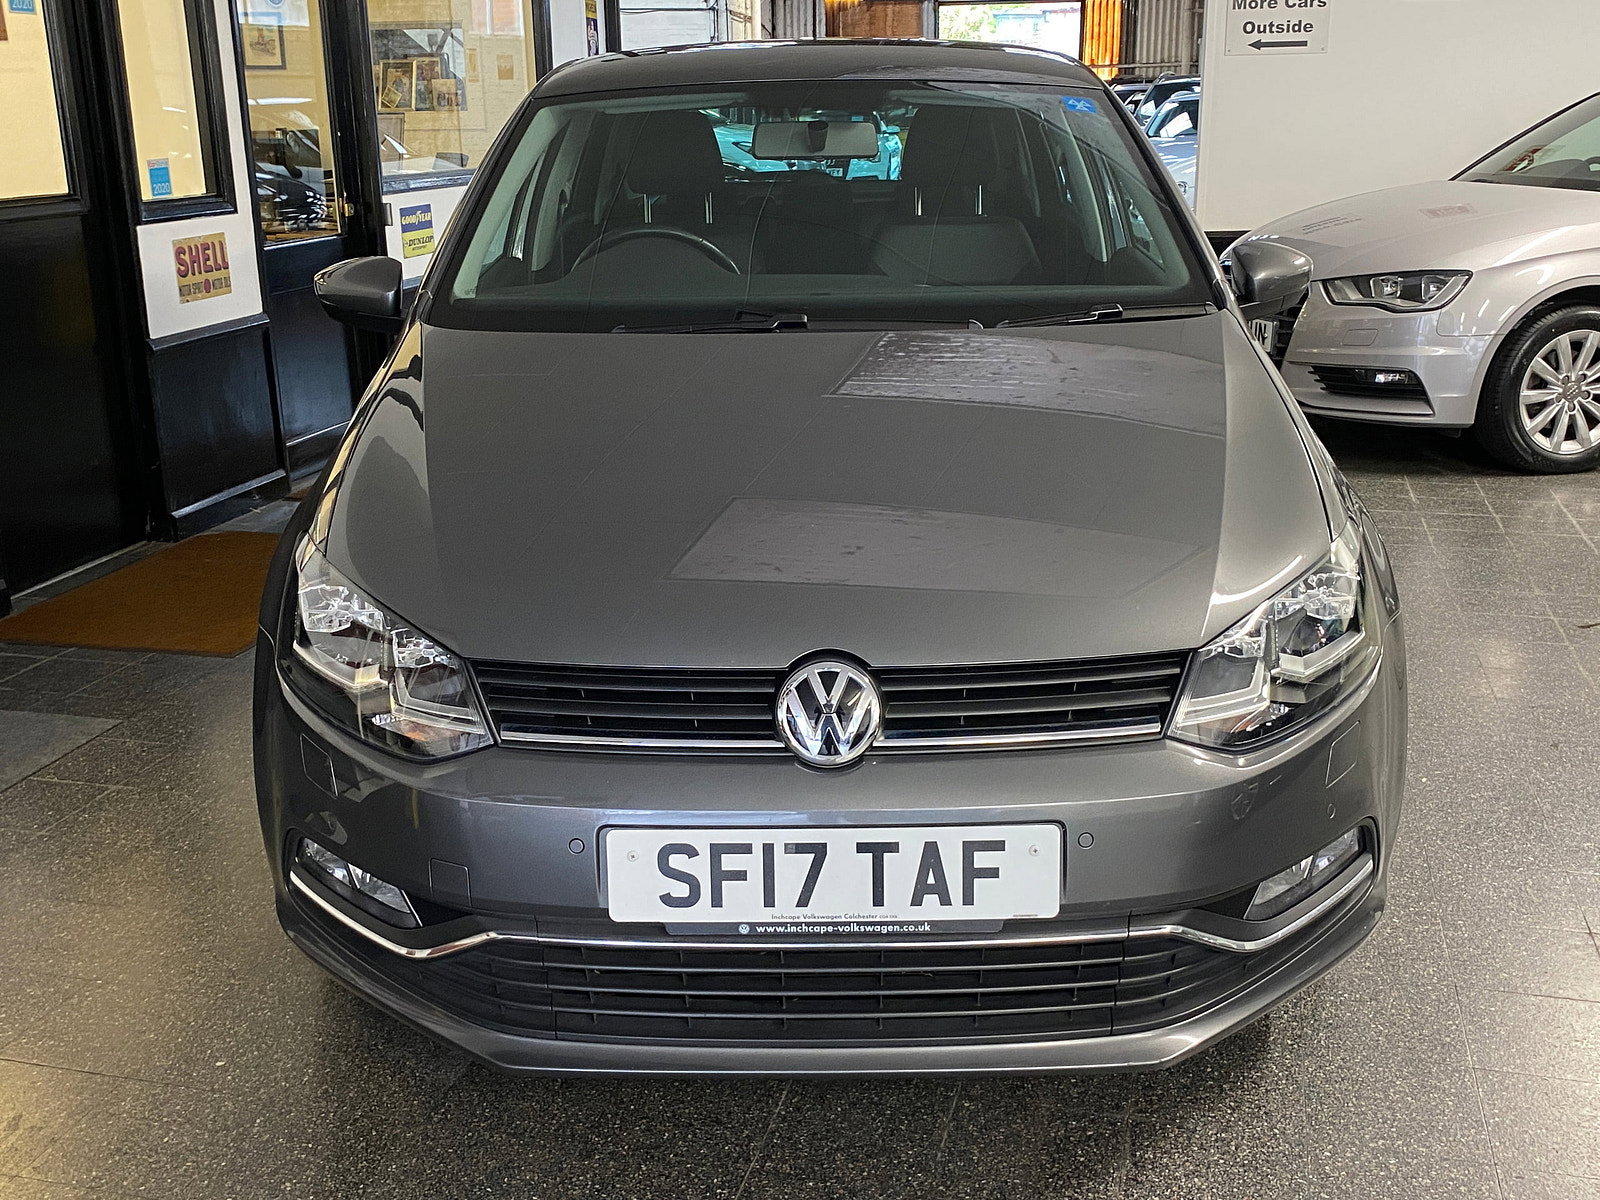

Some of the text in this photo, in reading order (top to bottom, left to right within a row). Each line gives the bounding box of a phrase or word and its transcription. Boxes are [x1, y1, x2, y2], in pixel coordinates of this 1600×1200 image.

[1232, 0, 1327, 10] More Cars
[1242, 20, 1314, 34] Outside
[153, 183, 171, 194] 2020
[408, 235, 434, 247] DUNLOP
[175, 240, 229, 278] SHELL
[657, 839, 1006, 909] SF17 TAF
[771, 913, 801, 921] Inchcape
[844, 912, 878, 920] Colchester
[755, 921, 931, 934] www.inchcape-volkswagen.co.uk
